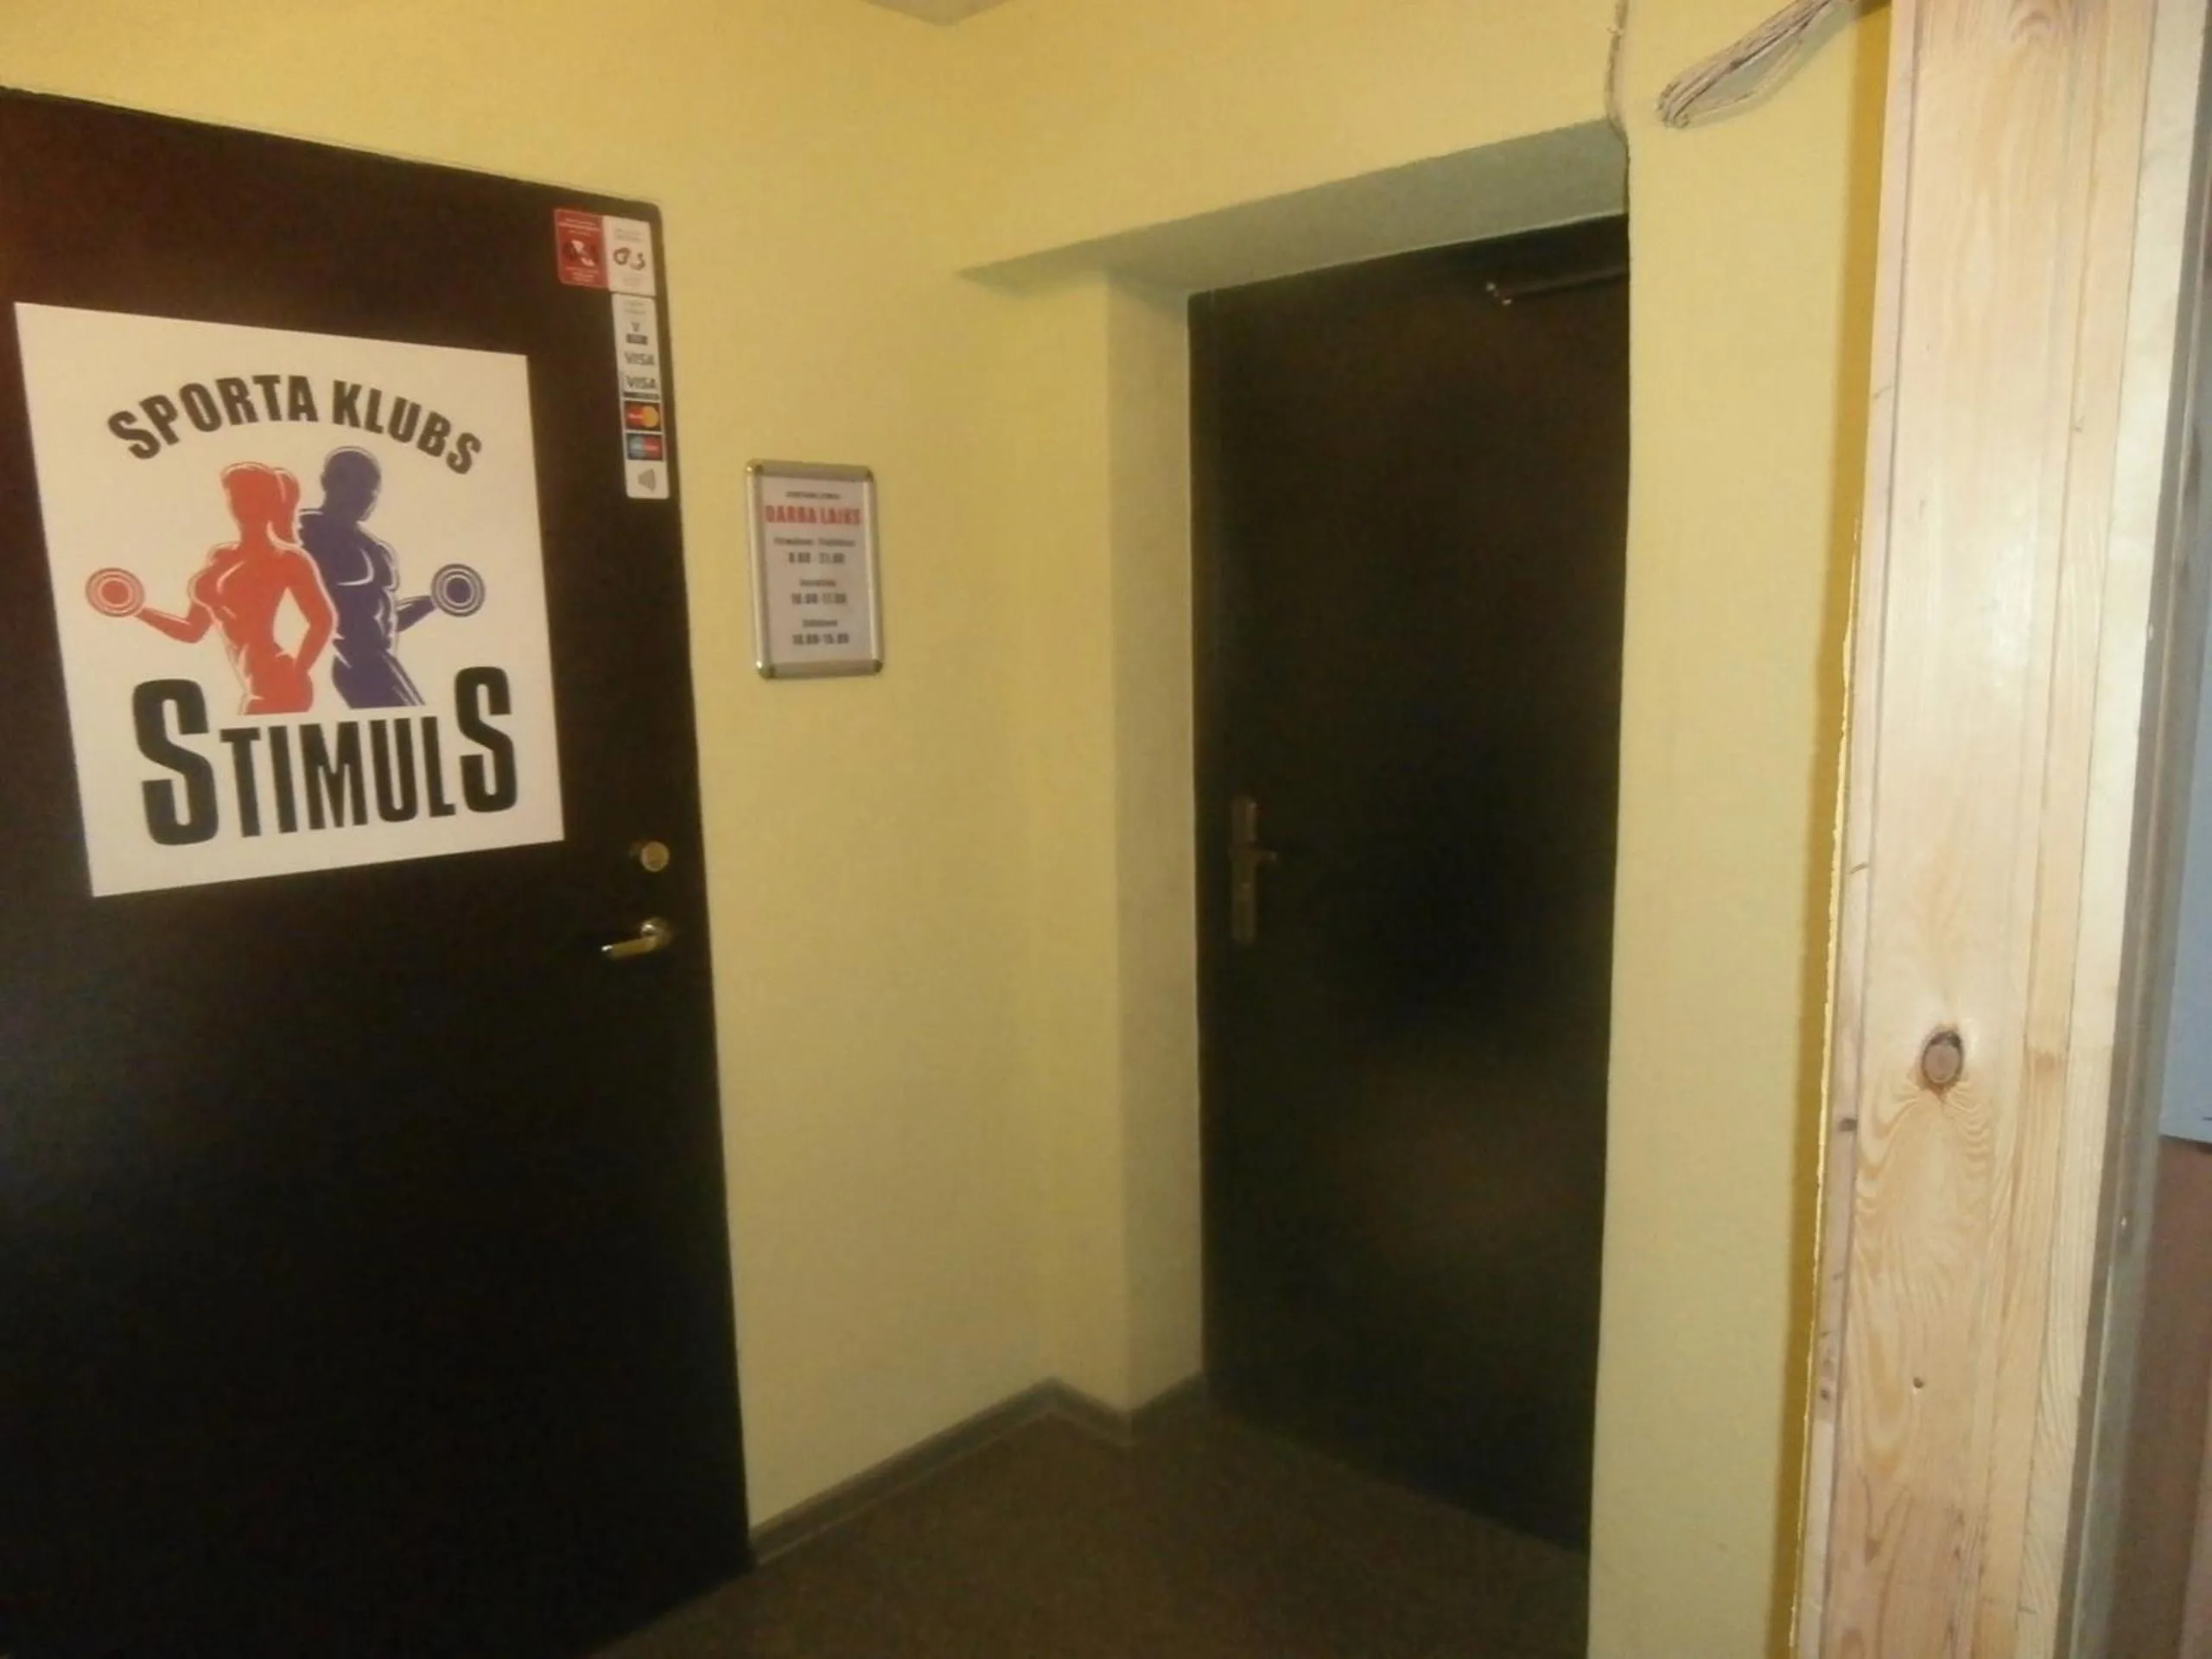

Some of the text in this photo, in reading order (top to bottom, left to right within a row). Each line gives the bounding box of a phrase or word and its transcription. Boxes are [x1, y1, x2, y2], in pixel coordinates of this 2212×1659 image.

[624, 352, 654, 365] VISA
[626, 376, 657, 389] VISA
[108, 375, 481, 474] SPORTA KLUBS
[766, 505, 817, 523] DARBA
[132, 666, 517, 845] STIMULS
